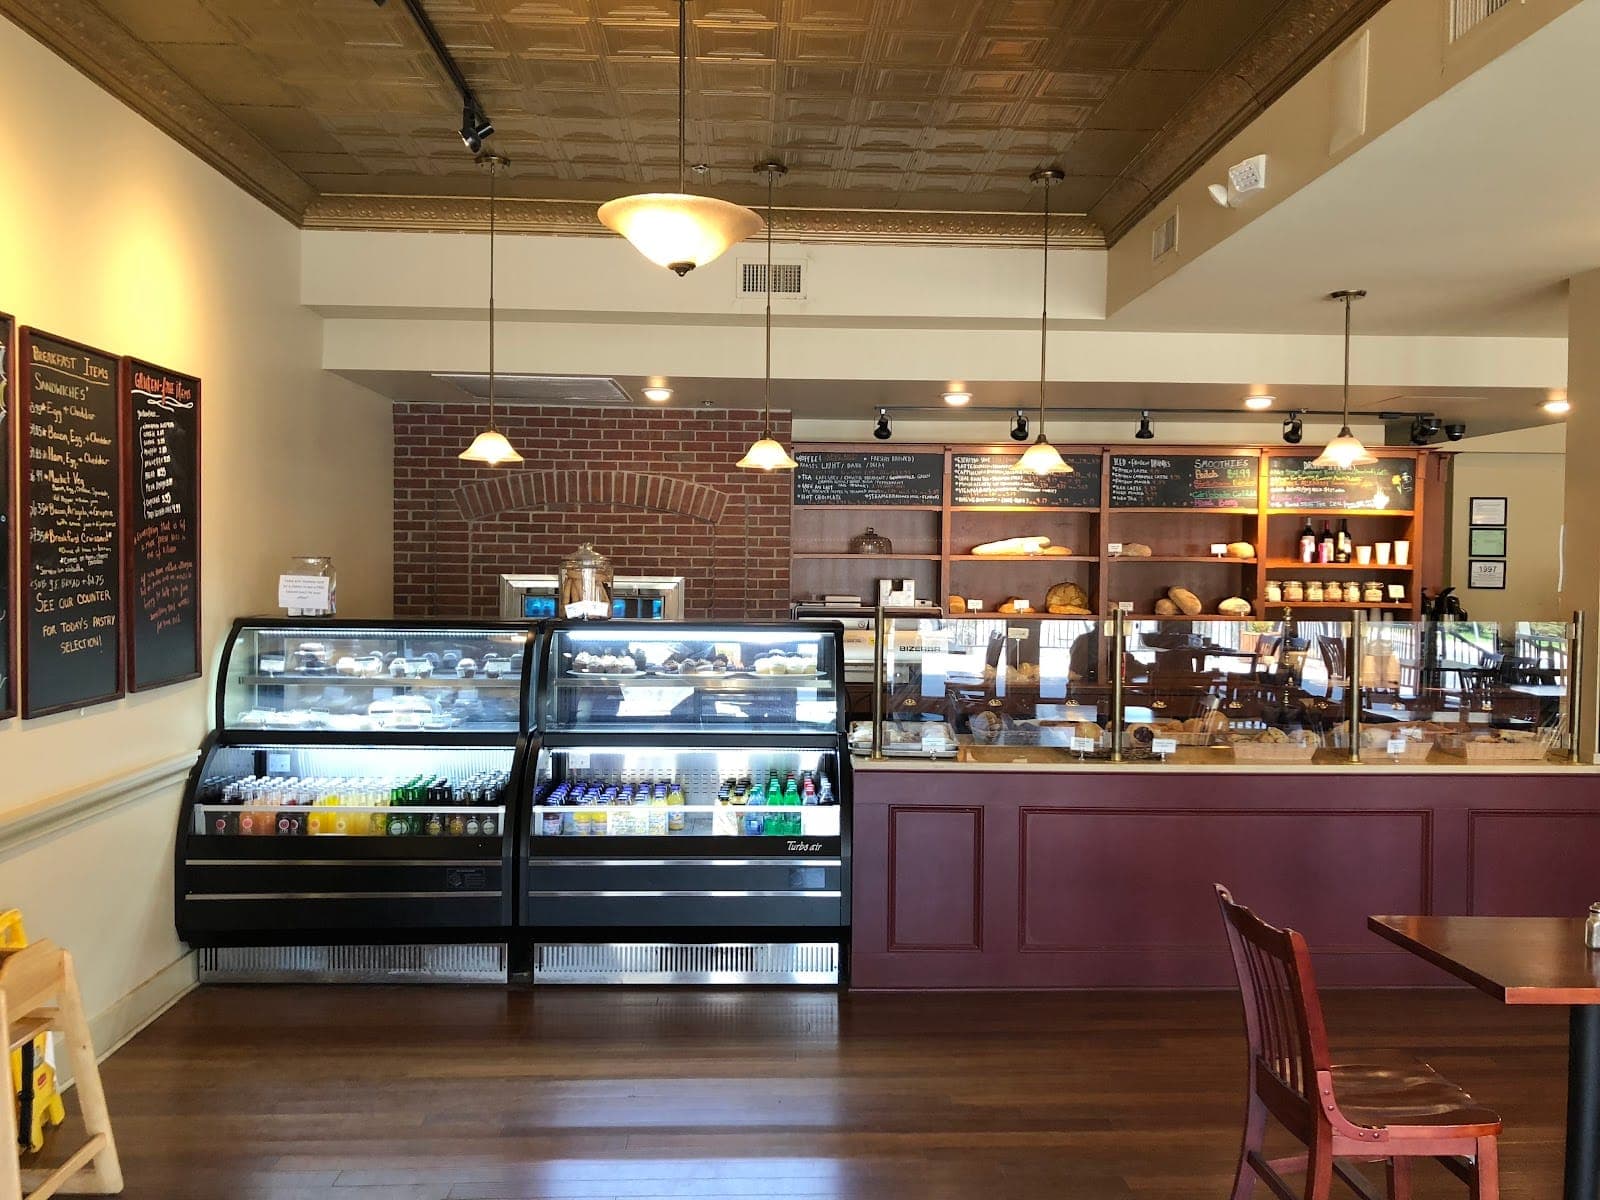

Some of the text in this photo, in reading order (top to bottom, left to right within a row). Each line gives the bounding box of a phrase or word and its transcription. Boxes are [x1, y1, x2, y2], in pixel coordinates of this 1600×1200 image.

[32, 346, 109, 380] BREAKFAST ITEMS
[1194, 459, 1249, 468] SMOOTHIES
[35, 589, 111, 613] SEE OUR COUNTER
[42, 615, 115, 637] FOR TODAY'S PASTRY
